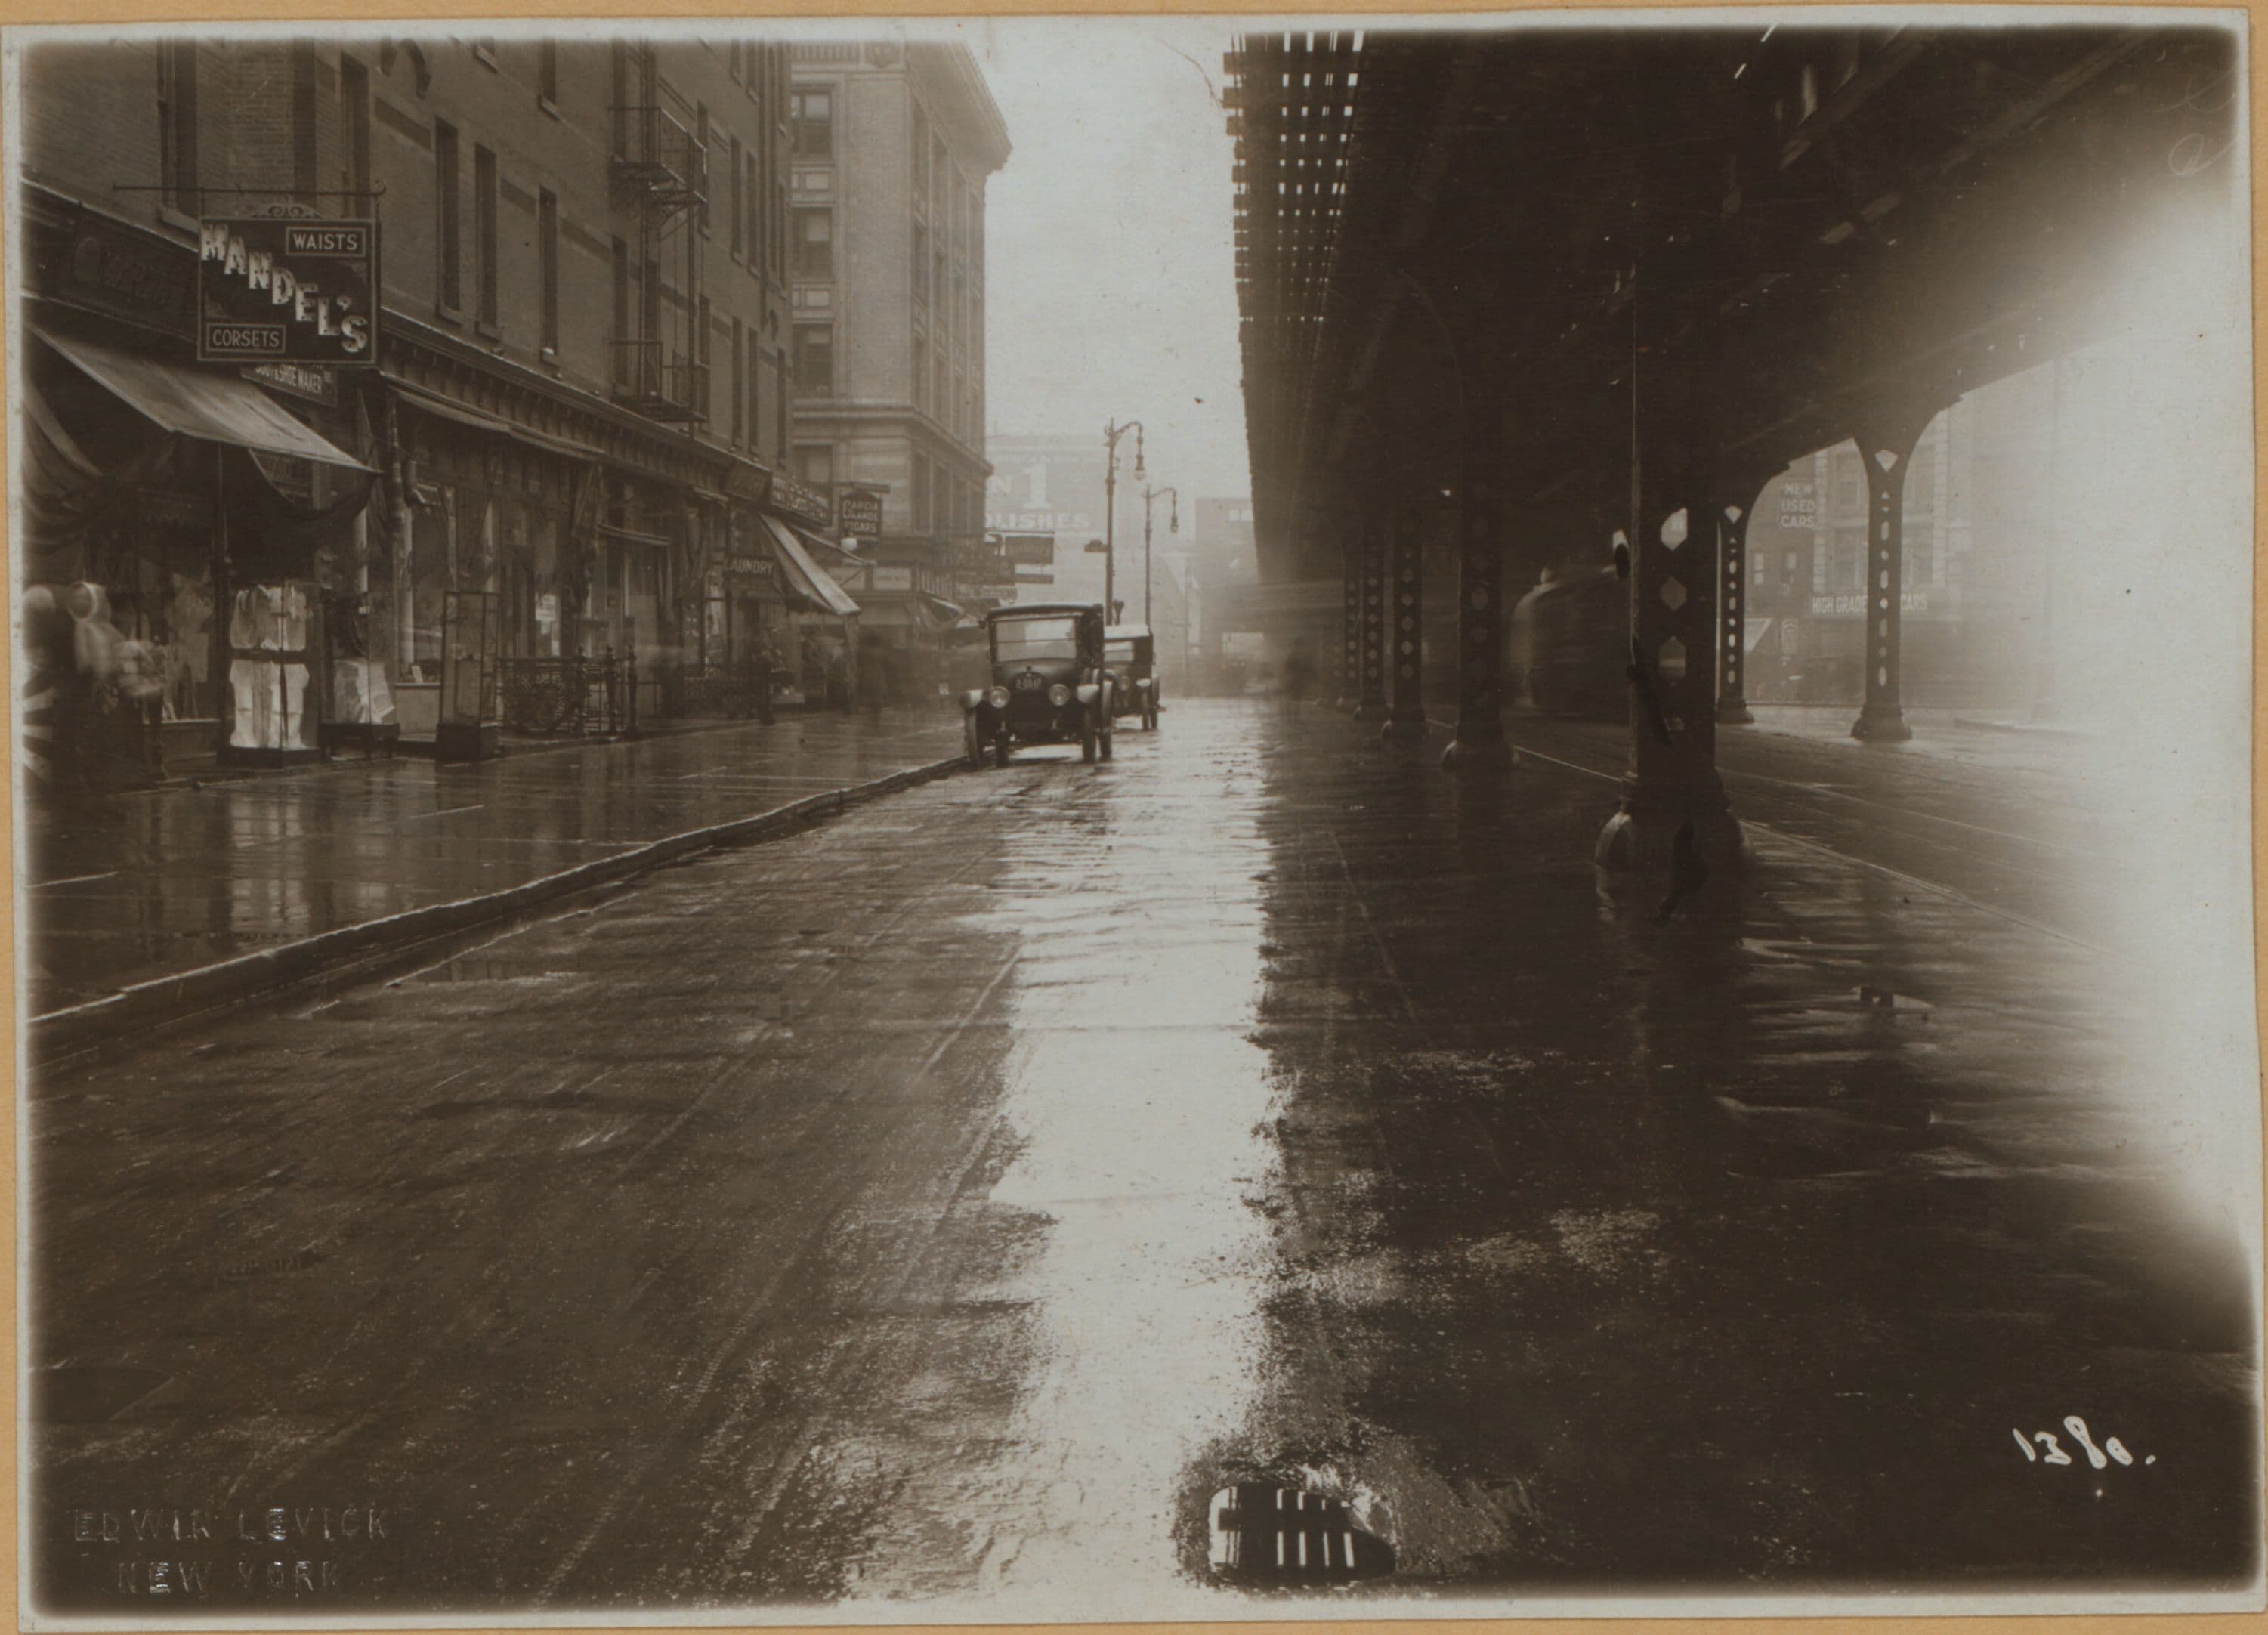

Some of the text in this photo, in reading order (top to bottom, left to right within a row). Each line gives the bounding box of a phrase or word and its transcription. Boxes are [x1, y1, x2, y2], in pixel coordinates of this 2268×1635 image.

[292, 233, 358, 252] WAISTS
[201, 224, 368, 354] MANDEL'S
[212, 329, 280, 348] CORSETS
[279, 364, 296, 387] SHOE
[298, 367, 322, 395] MAKER
[1023, 464, 1052, 508] 1
[1784, 482, 1813, 496] NEW
[1781, 499, 1816, 512] USED
[1781, 514, 1814, 528] CARS
[1812, 595, 1834, 614] HIGH
